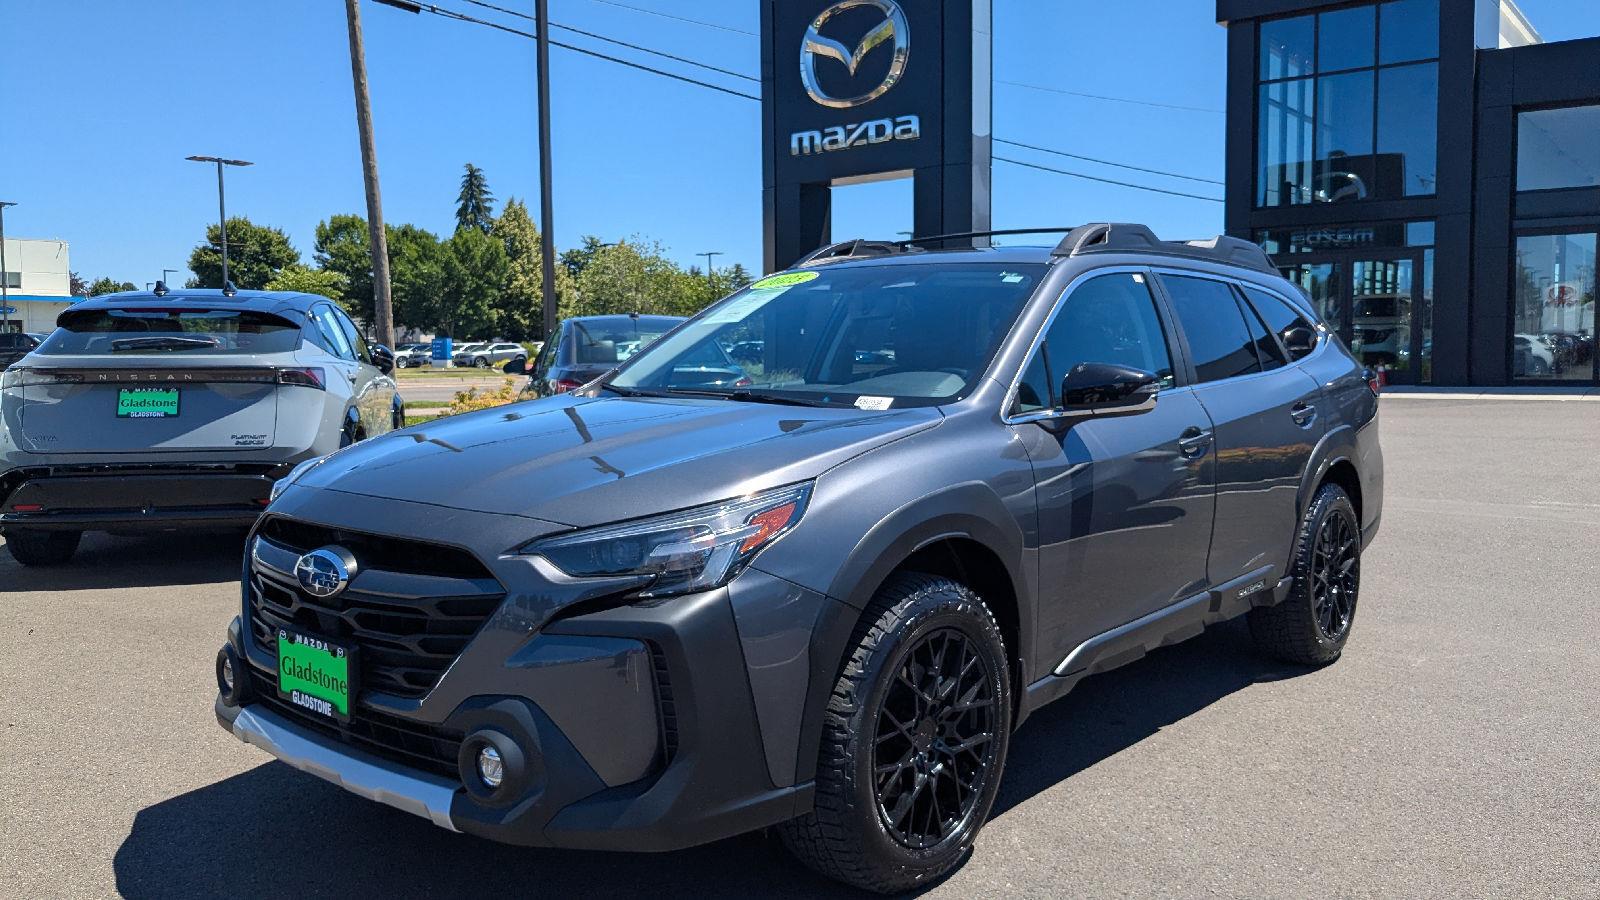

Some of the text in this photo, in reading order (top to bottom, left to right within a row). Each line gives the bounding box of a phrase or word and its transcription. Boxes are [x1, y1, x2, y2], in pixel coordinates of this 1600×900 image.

[120, 398, 177, 408] Gladstone
[295, 634, 329, 652] MAZDA
[282, 655, 347, 696] Gladstone
[292, 690, 332, 717] GLADSTONE
